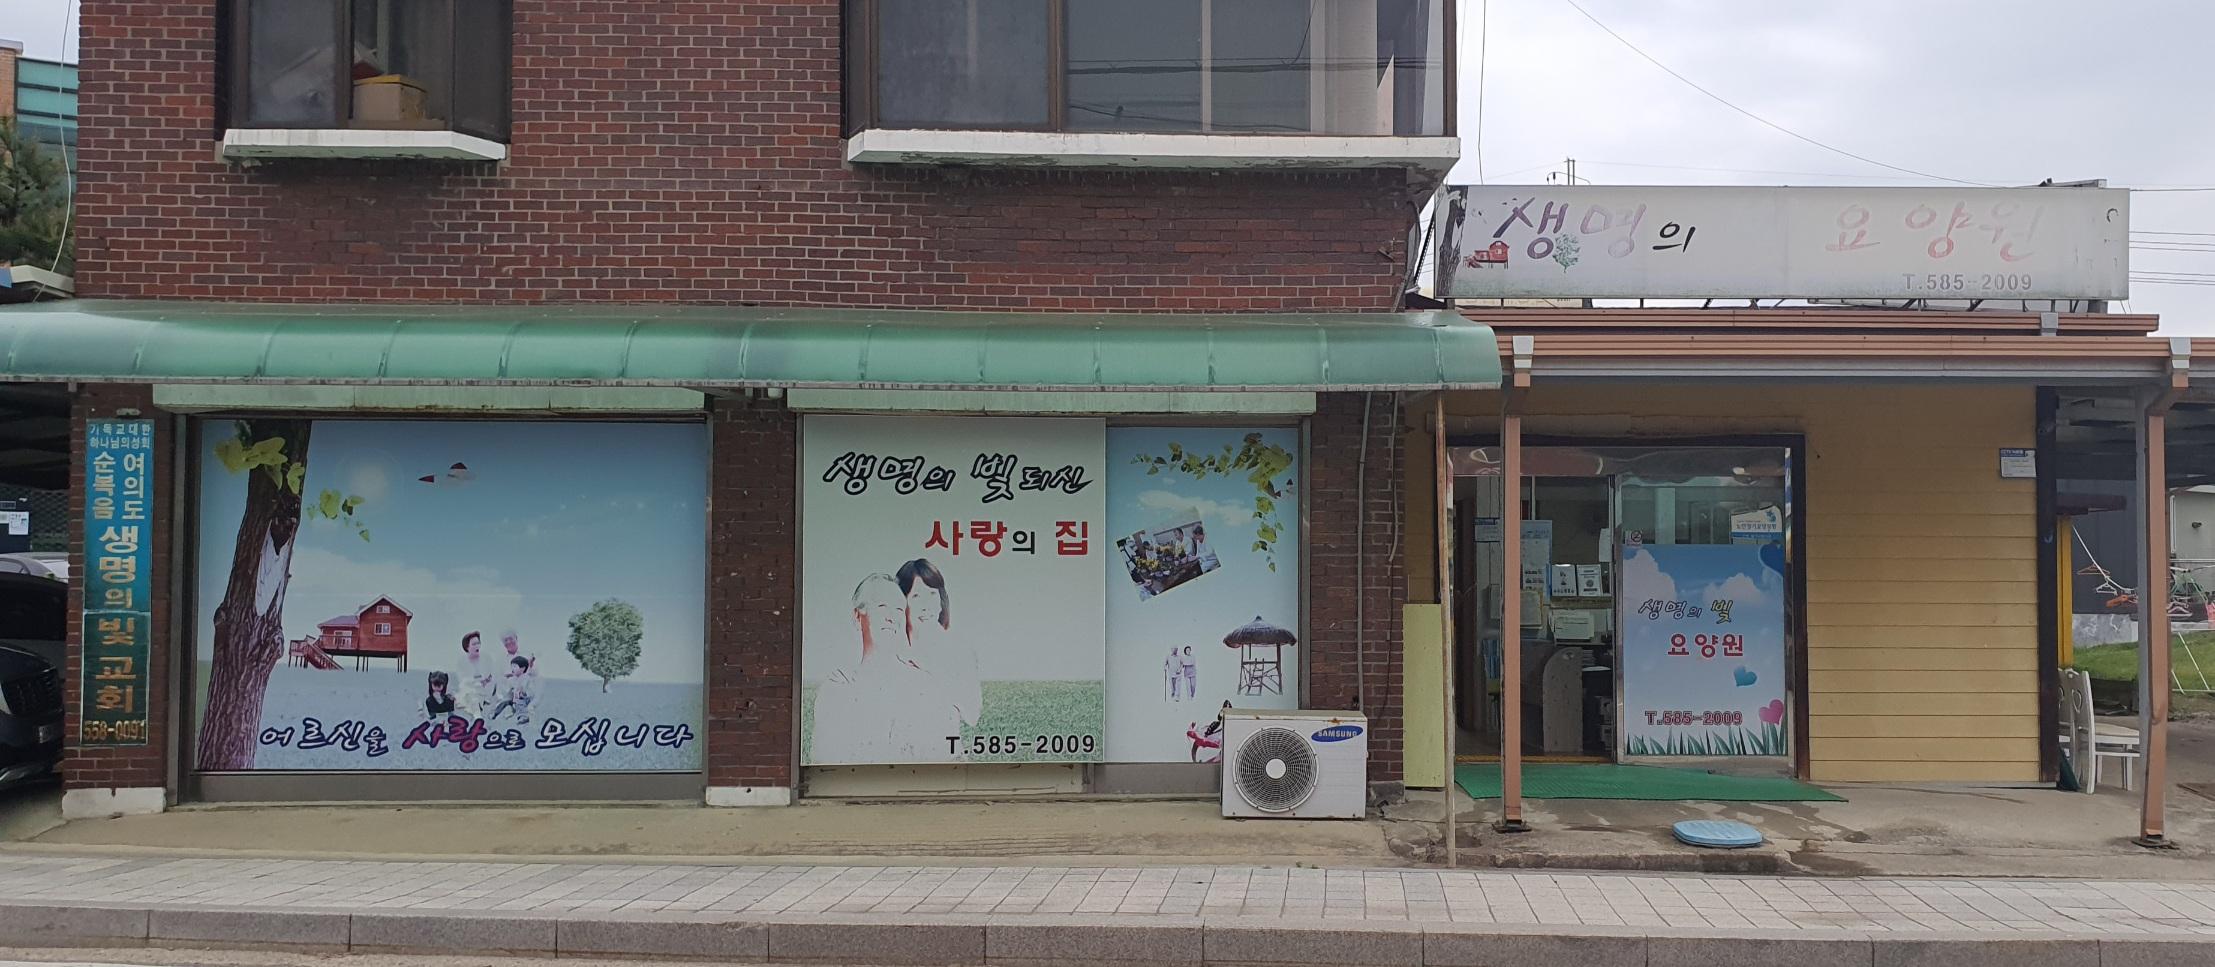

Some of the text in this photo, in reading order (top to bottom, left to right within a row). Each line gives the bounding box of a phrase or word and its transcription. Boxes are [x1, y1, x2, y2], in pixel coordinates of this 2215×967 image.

[1493, 197, 2036, 262] 생명의 요양원
[1903, 273, 2032, 290] T.585-2009
[90, 423, 151, 435] 기독교대한
[90, 436, 150, 449] 하나님의성회
[92, 451, 116, 520] 순복음
[122, 452, 145, 520] 여의도
[823, 452, 956, 495] 생명의
[925, 520, 1088, 557] 사랑의 집
[95, 526, 139, 713] 생명의 빛 교회
[1638, 599, 1733, 624] 생명의 빛
[1667, 633, 1744, 658] 요양원
[1645, 710, 1743, 725] T.585-2009
[260, 716, 692, 757] 어르신을 사랑으로 모십니다
[946, 735, 1095, 755] T.585-2009
[1318, 729, 1358, 738] SAMSUNG
